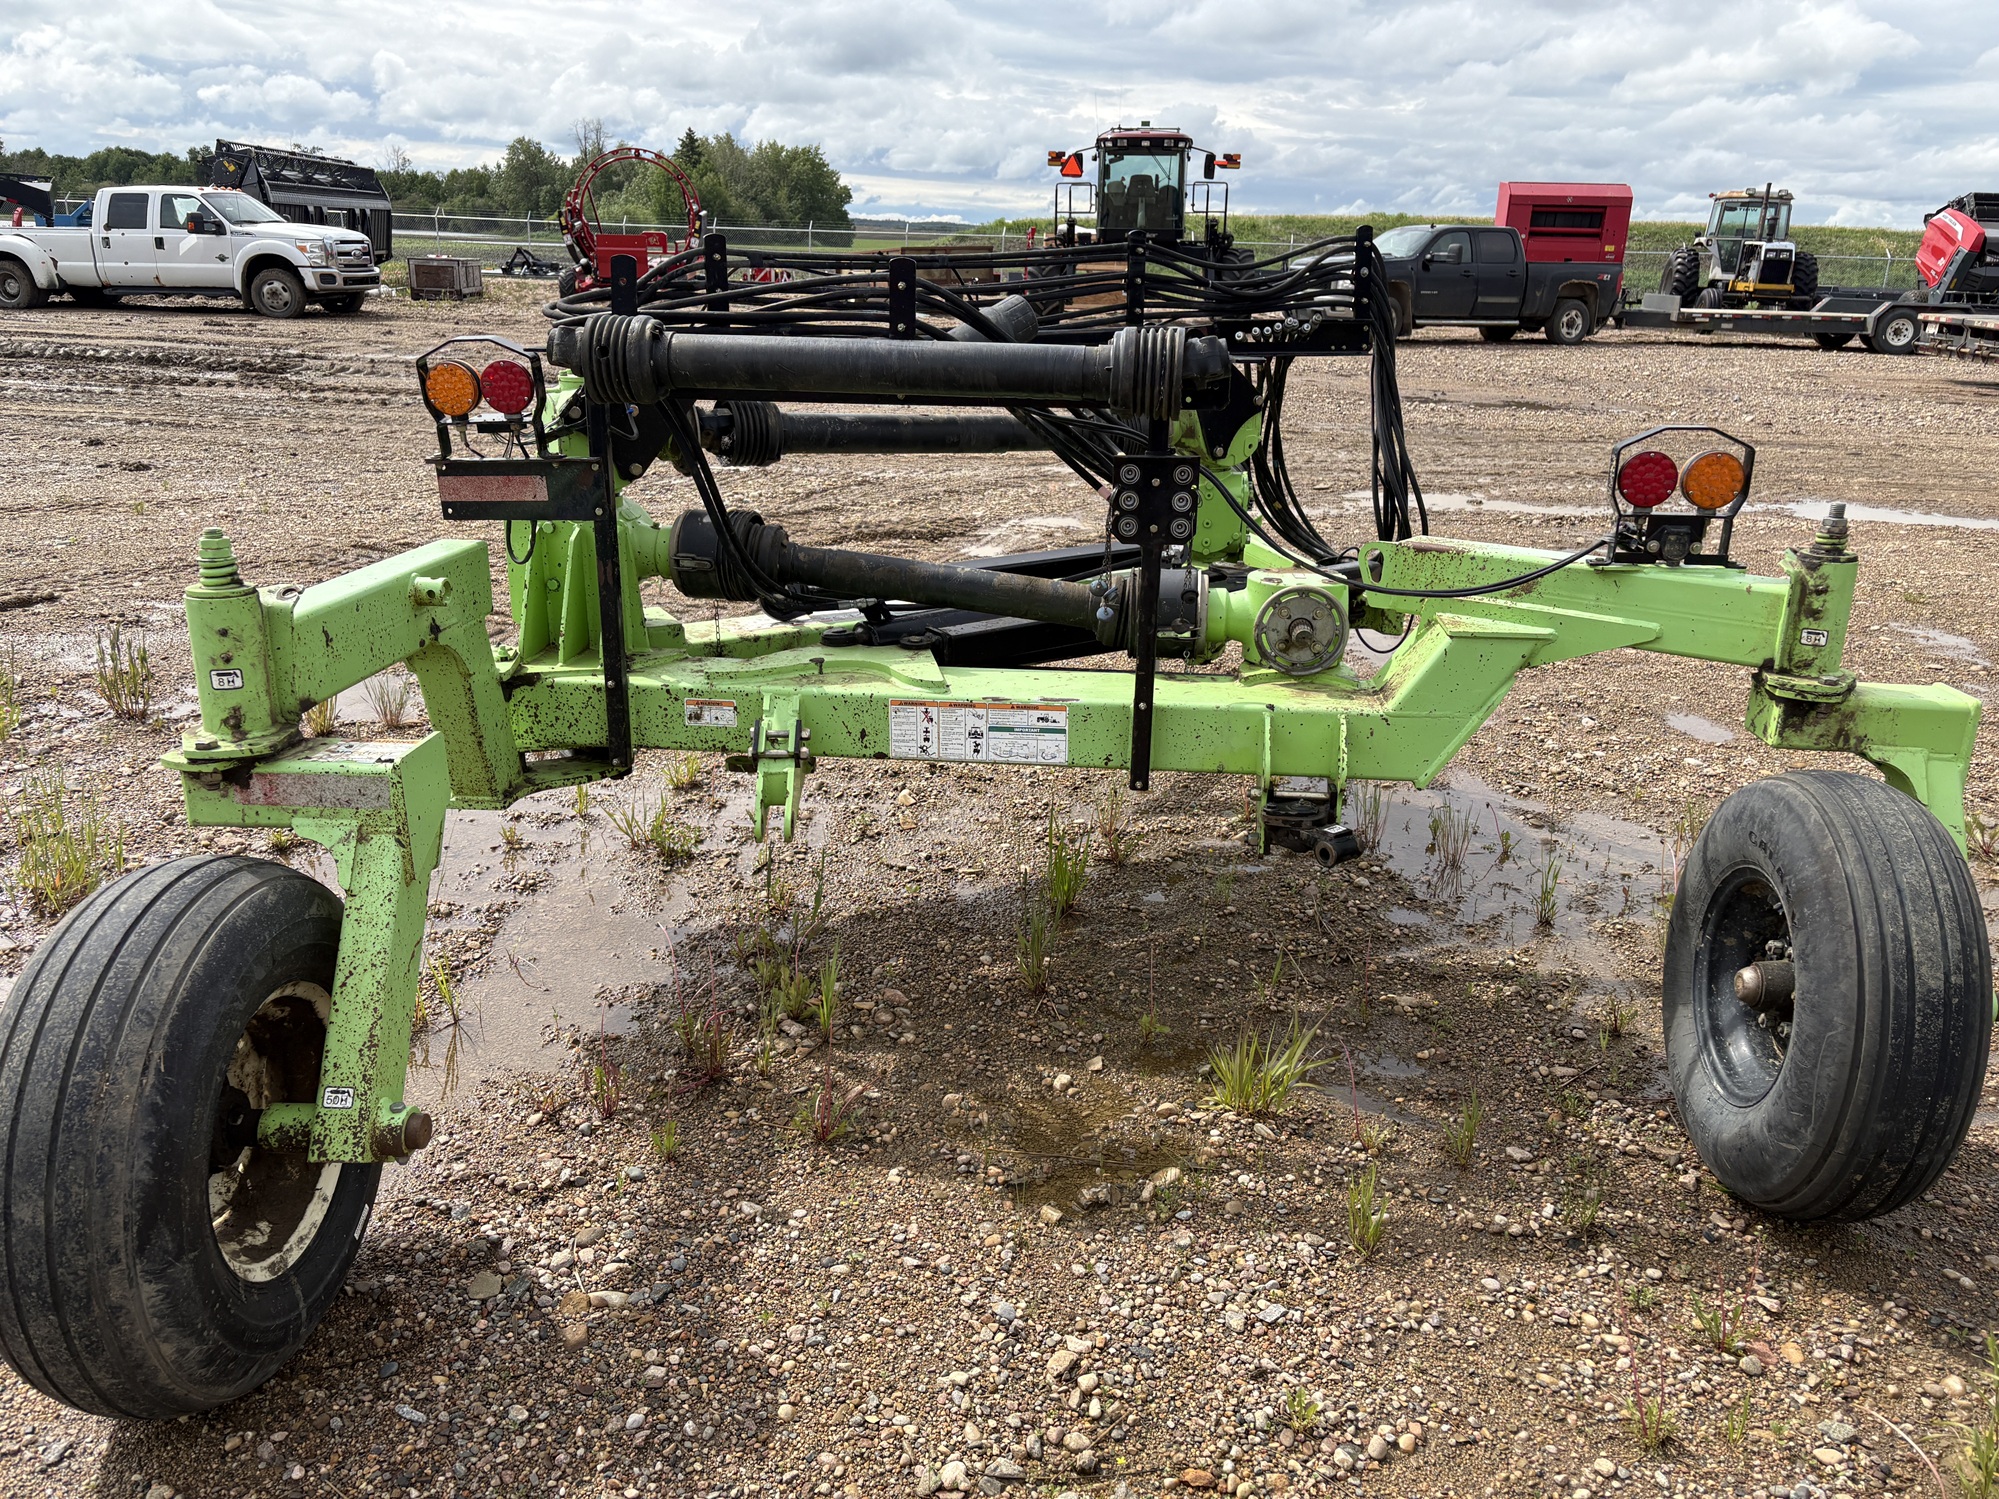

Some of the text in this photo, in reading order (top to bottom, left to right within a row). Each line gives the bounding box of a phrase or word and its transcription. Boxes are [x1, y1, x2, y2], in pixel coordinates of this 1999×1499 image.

[1806, 635, 1812, 643] 8
[218, 678, 225, 686] 8
[326, 1095, 339, 1105] 50
